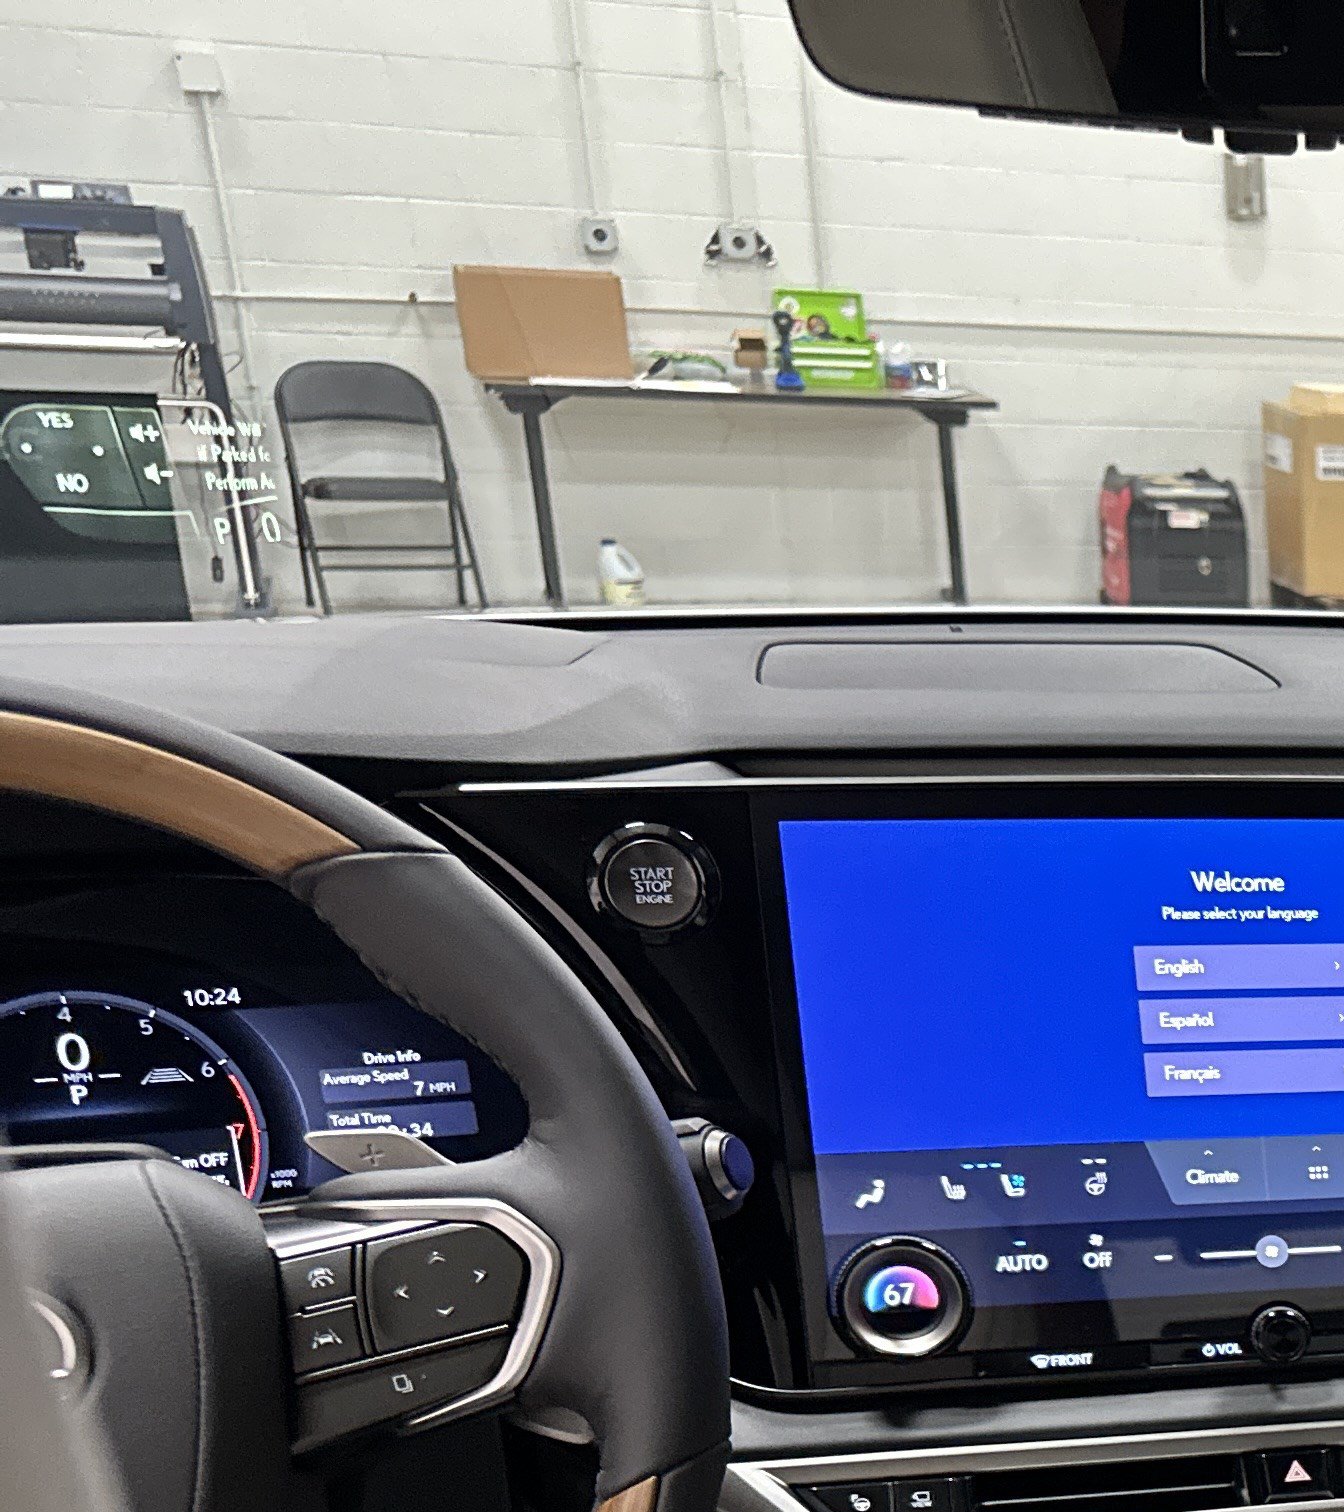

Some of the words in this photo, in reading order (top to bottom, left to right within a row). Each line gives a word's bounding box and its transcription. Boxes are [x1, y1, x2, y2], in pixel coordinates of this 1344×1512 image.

[36, 411, 73, 428] YES
[55, 473, 89, 493] NO
[214, 518, 231, 544] P
[630, 867, 674, 880] START
[1190, 871, 1285, 892] Welcome
[634, 881, 672, 893] STOP
[635, 894, 673, 905] ENGINE
[1161, 906, 1200, 920] Please
[1203, 907, 1237, 919] select
[1240, 907, 1266, 922] your
[1267, 906, 1319, 921] language
[1154, 959, 1204, 977] English
[184, 987, 241, 1006] 10:24
[57, 1006, 72, 1022] 4
[1159, 1012, 1215, 1031] Español
[139, 1019, 153, 1035] 5
[57, 1033, 90, 1071] 0
[362, 1052, 395, 1064] Drive
[397, 1050, 421, 1063] Info
[201, 1062, 215, 1078] 6
[323, 1073, 371, 1086] Average
[372, 1068, 409, 1083] Speed
[1164, 1065, 1221, 1084] Français
[63, 1073, 93, 1084] MPH
[70, 1085, 88, 1105] P
[413, 1081, 424, 1096] 7
[429, 1082, 456, 1093] MPH
[329, 1114, 359, 1127] Total
[361, 1112, 391, 1124] Time
[199, 1152, 228, 1168] OFF
[1185, 1169, 1239, 1185] Climate
[996, 1255, 1048, 1272] AUTO
[1083, 1252, 1113, 1269] Off
[883, 1282, 915, 1305] 67
[1216, 1342, 1243, 1356] VOL
[1050, 1353, 1094, 1367] FRONT
